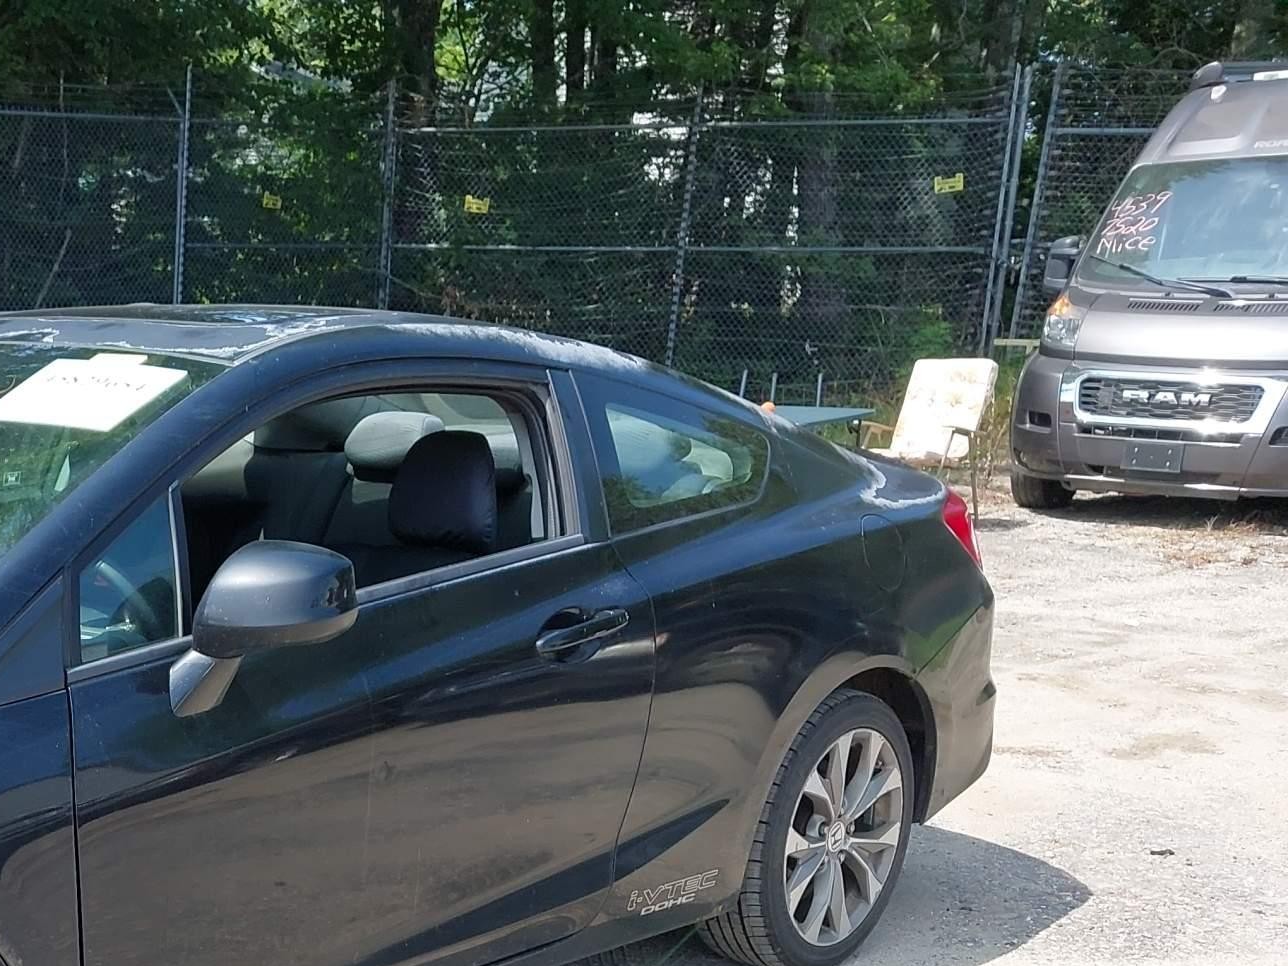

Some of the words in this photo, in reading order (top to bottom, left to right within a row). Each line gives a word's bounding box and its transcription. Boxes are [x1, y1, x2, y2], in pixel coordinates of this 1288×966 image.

[1112, 191, 1173, 218] 4539
[1101, 216, 1159, 236] 7520
[1122, 389, 1212, 406] RAM
[639, 893, 697, 917] DOHC
